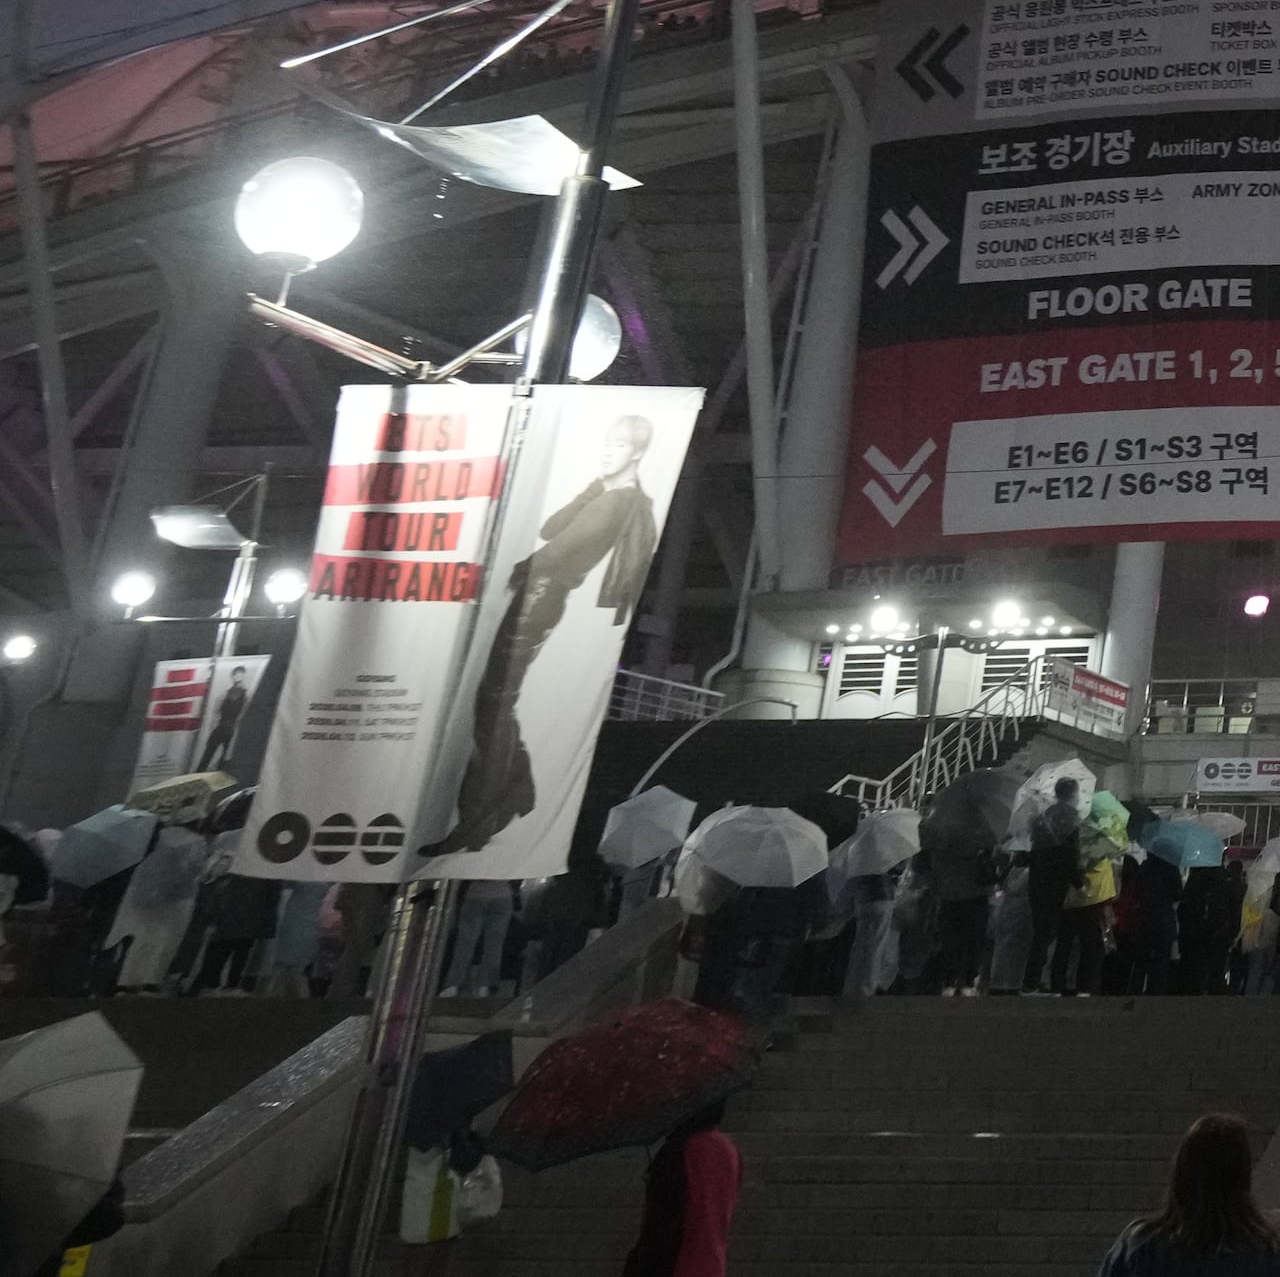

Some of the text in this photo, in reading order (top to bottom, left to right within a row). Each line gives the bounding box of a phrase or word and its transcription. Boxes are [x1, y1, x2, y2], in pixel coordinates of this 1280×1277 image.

[1107, 9, 1159, 22] EXPRESS
[1161, 4, 1199, 17] BOOTH
[1212, 2, 1268, 13] SPONSOR
[988, 41, 1018, 59] 공식
[1118, 27, 1148, 44] 부스
[1211, 21, 1272, 38] 티켓박스
[1076, 49, 1118, 61] PICKUP
[1121, 46, 1162, 57] BOOTH
[1210, 39, 1277, 51] TICKET BOX
[1096, 66, 1159, 84] SOUND
[1163, 61, 1222, 78] CHECK
[1226, 58, 1273, 76] 이벤트
[1088, 86, 1130, 98] SOUND
[1132, 82, 1171, 95] CHECK
[1174, 80, 1209, 92] EVENT
[1212, 78, 1252, 90] BOOTH
[978, 141, 1037, 175] 보조
[1045, 129, 1135, 171] 경기장
[1147, 137, 1231, 159] Auxiliary
[982, 186, 1165, 216] GENERAL IN-PASS 부스
[1191, 183, 1242, 200] ARMY
[979, 217, 1032, 230] GENERAL
[1075, 209, 1116, 222] BOOTH
[976, 237, 1038, 255] SOUND
[1119, 226, 1150, 246] 전용
[1154, 224, 1182, 241] 부스
[975, 250, 1096, 270] SOUND CHECK BOOTH
[1028, 278, 1253, 320] FLOOR GATE
[979, 356, 1068, 393] EAST
[1078, 350, 1176, 384] GATE
[1189, 349, 1217, 384] 1,
[1229, 348, 1264, 384] 2,
[384, 412, 451, 452] BTS
[1008, 431, 1258, 469] E1~E6 / S1~S3 구역
[357, 462, 472, 501] WORLD
[994, 466, 1268, 504] E7~E12 / S6~S8 구역
[362, 512, 449, 551] TOUR
[313, 562, 468, 602] ARIRANG
